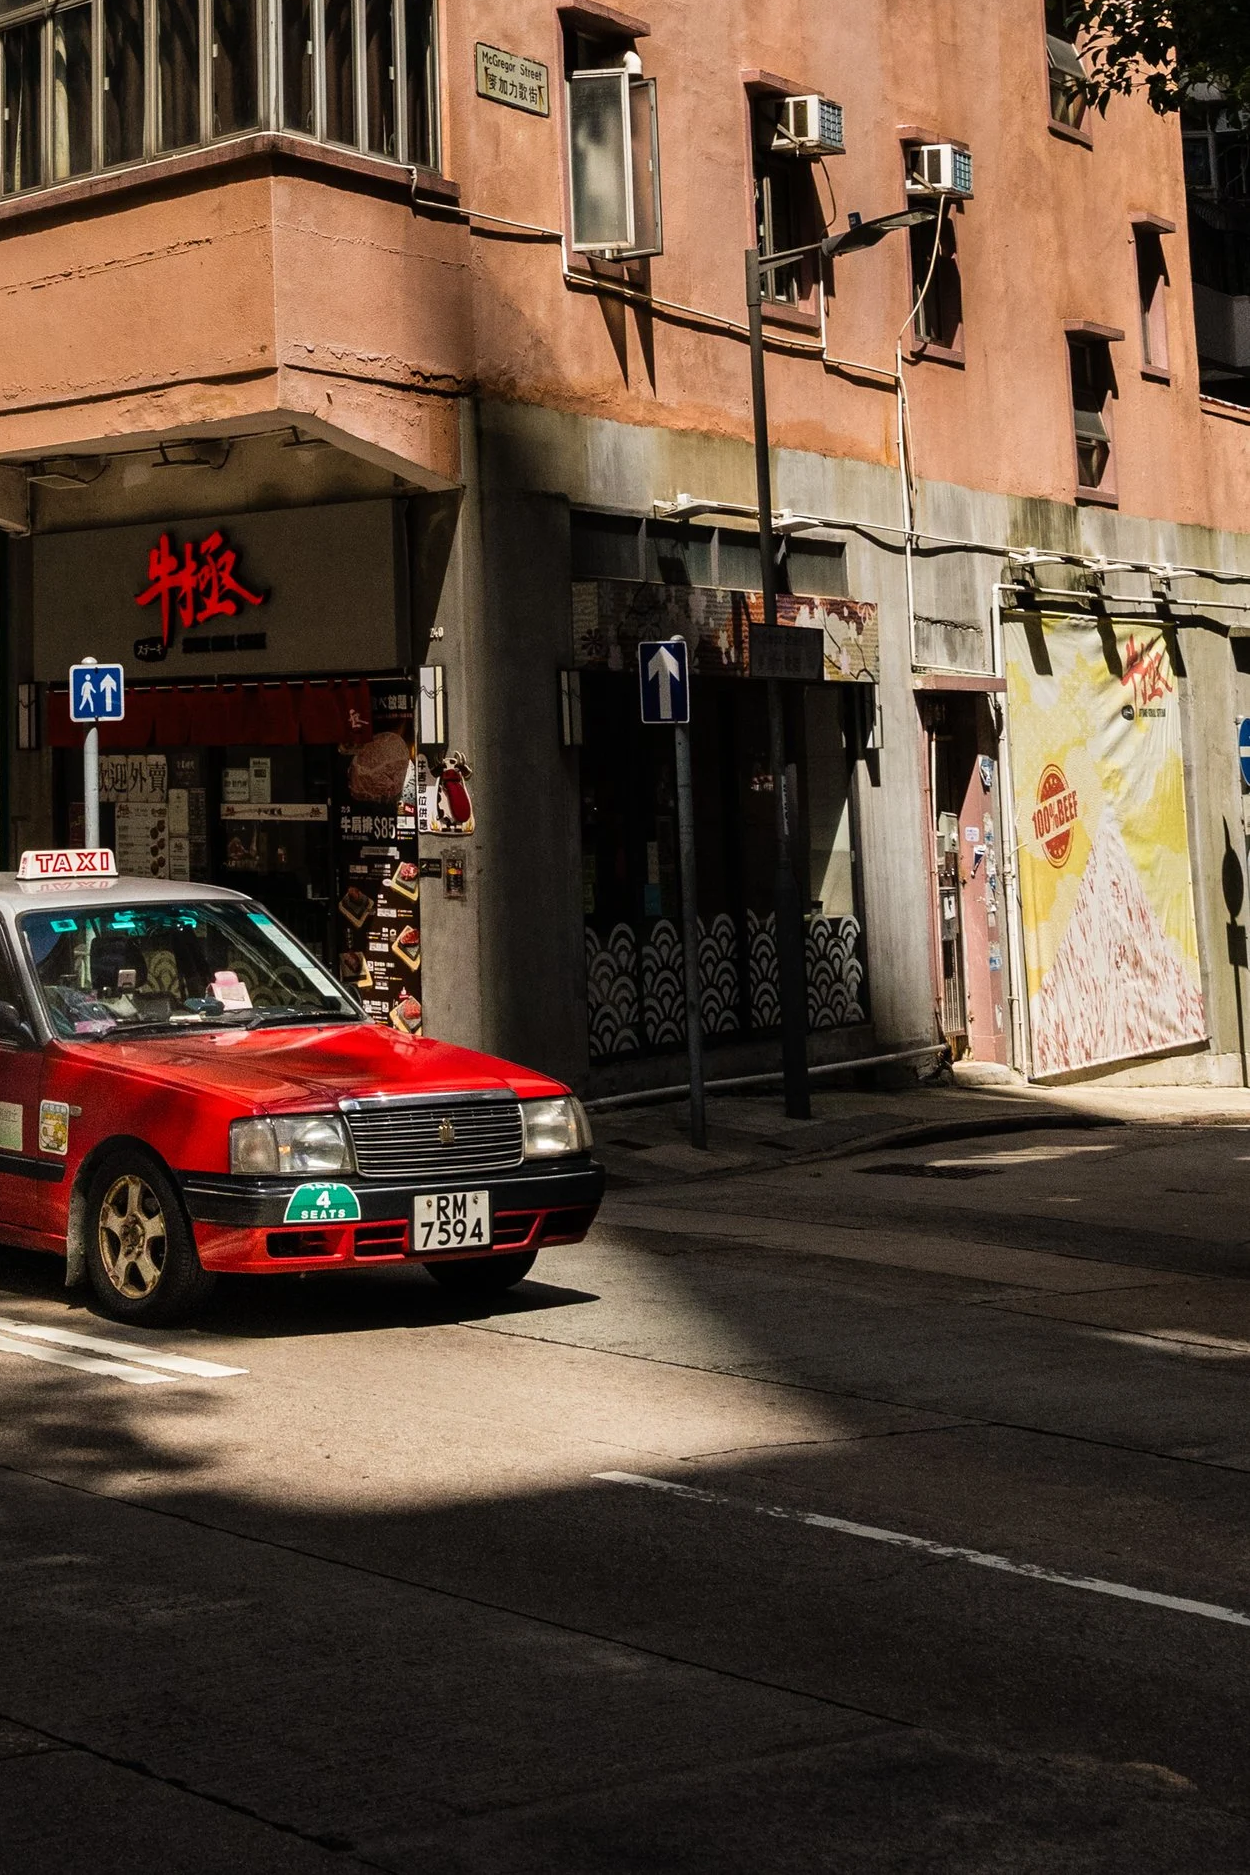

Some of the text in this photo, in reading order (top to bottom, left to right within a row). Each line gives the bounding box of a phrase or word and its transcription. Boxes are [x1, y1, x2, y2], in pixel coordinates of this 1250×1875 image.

[482, 51, 542, 82] McGregor Street
[488, 73, 538, 105] 麥加力歌街
[136, 643, 163, 656] ステーキ
[373, 816, 396, 840] $85
[36, 852, 109, 873] TAXI
[315, 1190, 331, 1208] 4
[436, 1194, 468, 1220] RM
[300, 1208, 346, 1220] SEATS
[420, 1217, 484, 1248] 7594
